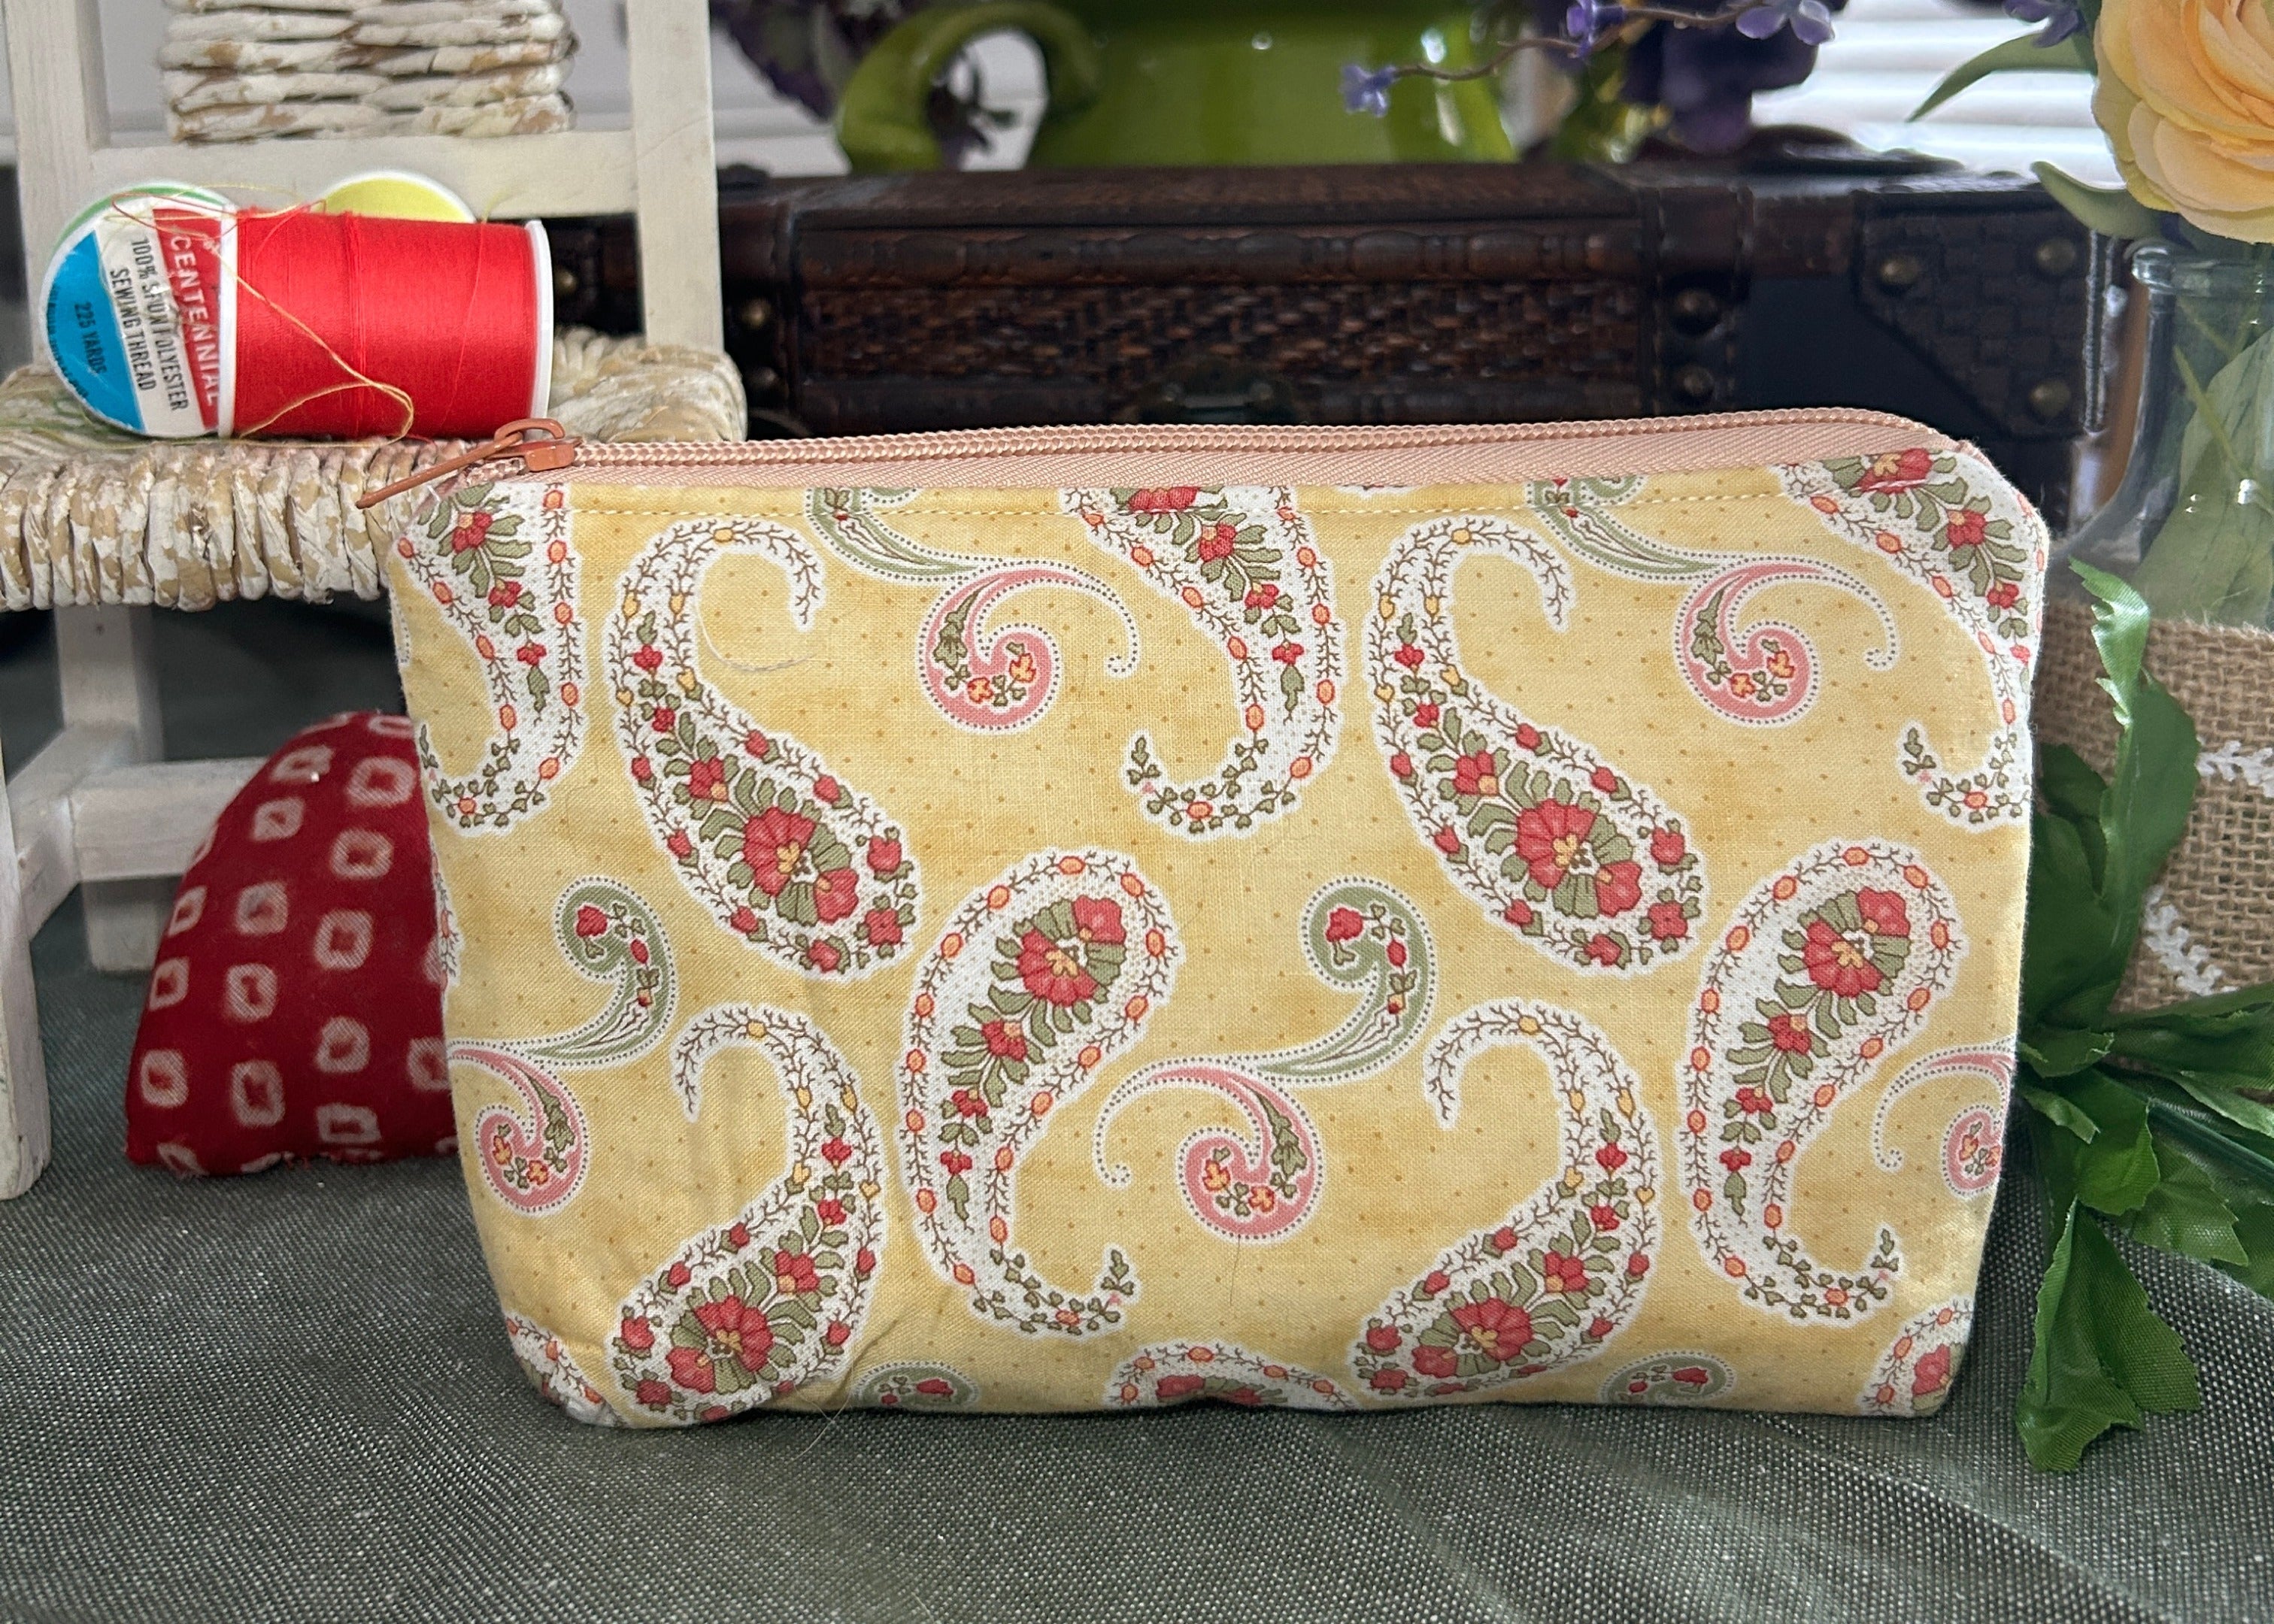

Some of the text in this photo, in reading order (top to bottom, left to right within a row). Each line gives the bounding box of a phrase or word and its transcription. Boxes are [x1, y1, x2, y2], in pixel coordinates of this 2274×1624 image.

[131, 238, 158, 279] 100%
[74, 302, 108, 374] 225 YARDS
[110, 270, 156, 391] SEWING THREAD
[169, 235, 219, 405] CENTENNIAL
